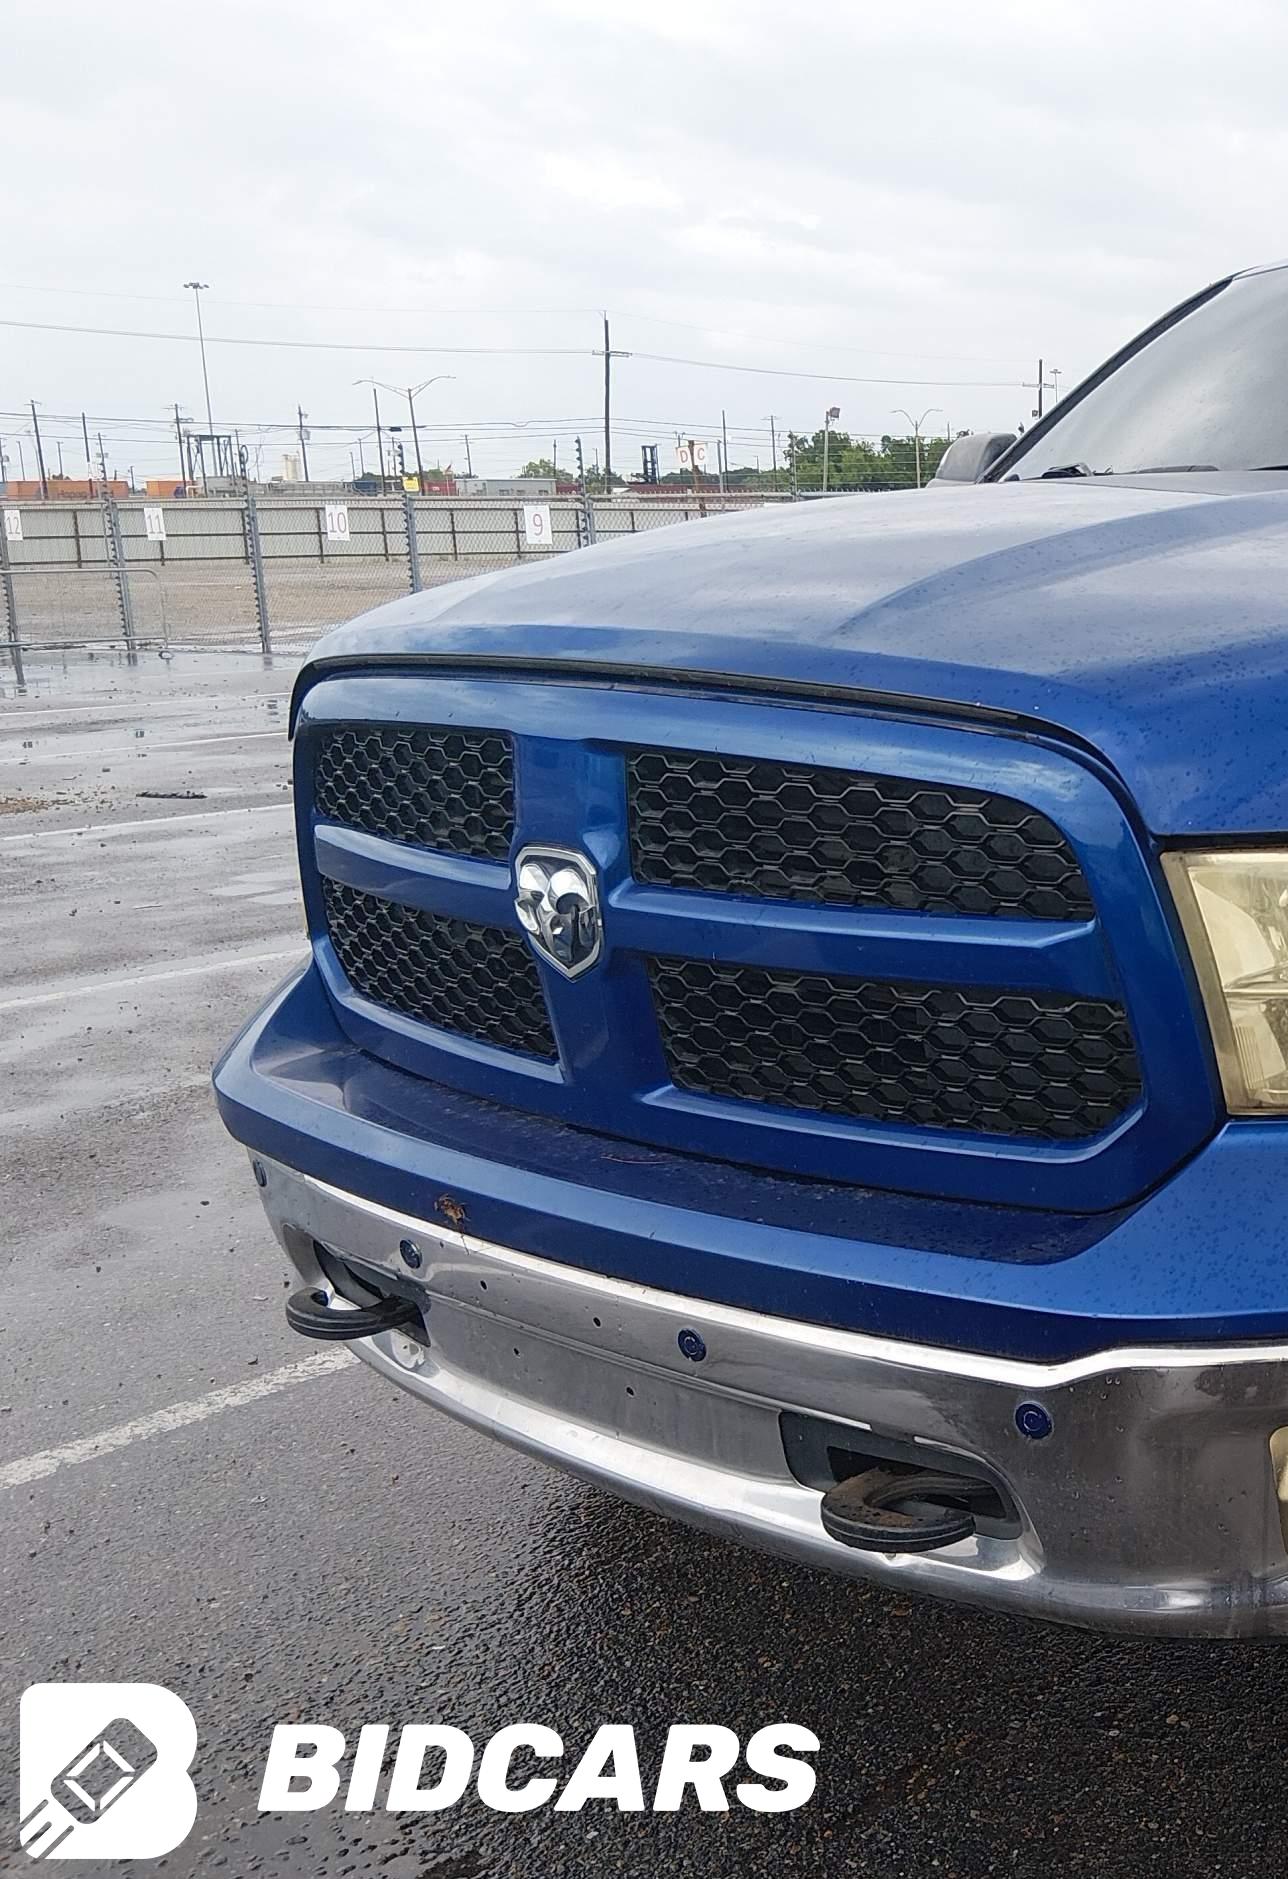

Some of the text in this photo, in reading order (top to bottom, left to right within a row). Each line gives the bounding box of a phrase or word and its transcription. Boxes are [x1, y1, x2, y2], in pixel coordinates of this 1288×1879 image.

[680, 449, 688, 463] D
[697, 447, 705, 461] C
[6, 516, 21, 535] 12
[146, 514, 164, 535] 11
[327, 511, 347, 534] 10
[532, 513, 543, 536] 9
